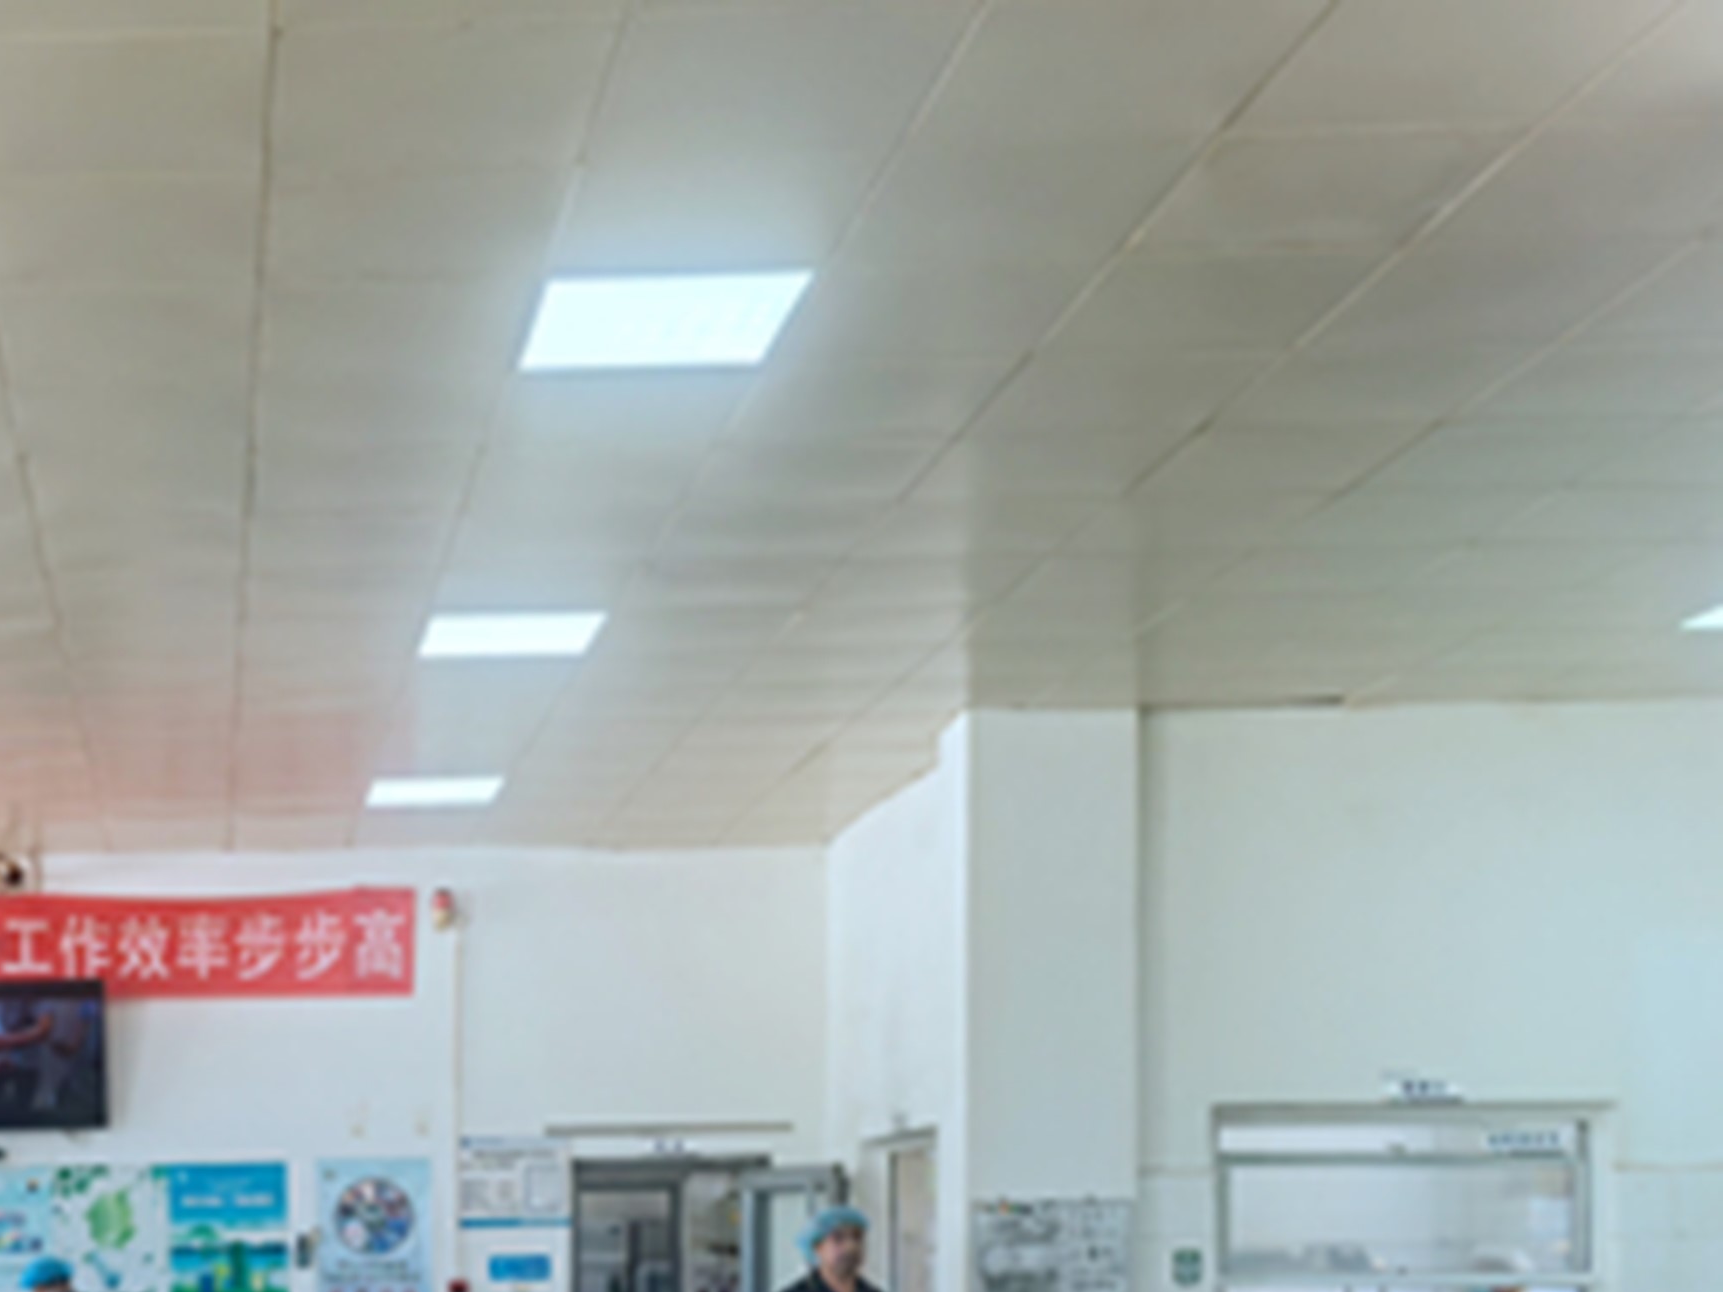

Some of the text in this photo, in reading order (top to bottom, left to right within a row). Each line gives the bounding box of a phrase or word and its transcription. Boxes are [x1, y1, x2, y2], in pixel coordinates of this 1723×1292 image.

[0, 908, 406, 980] 工作效率步步高
